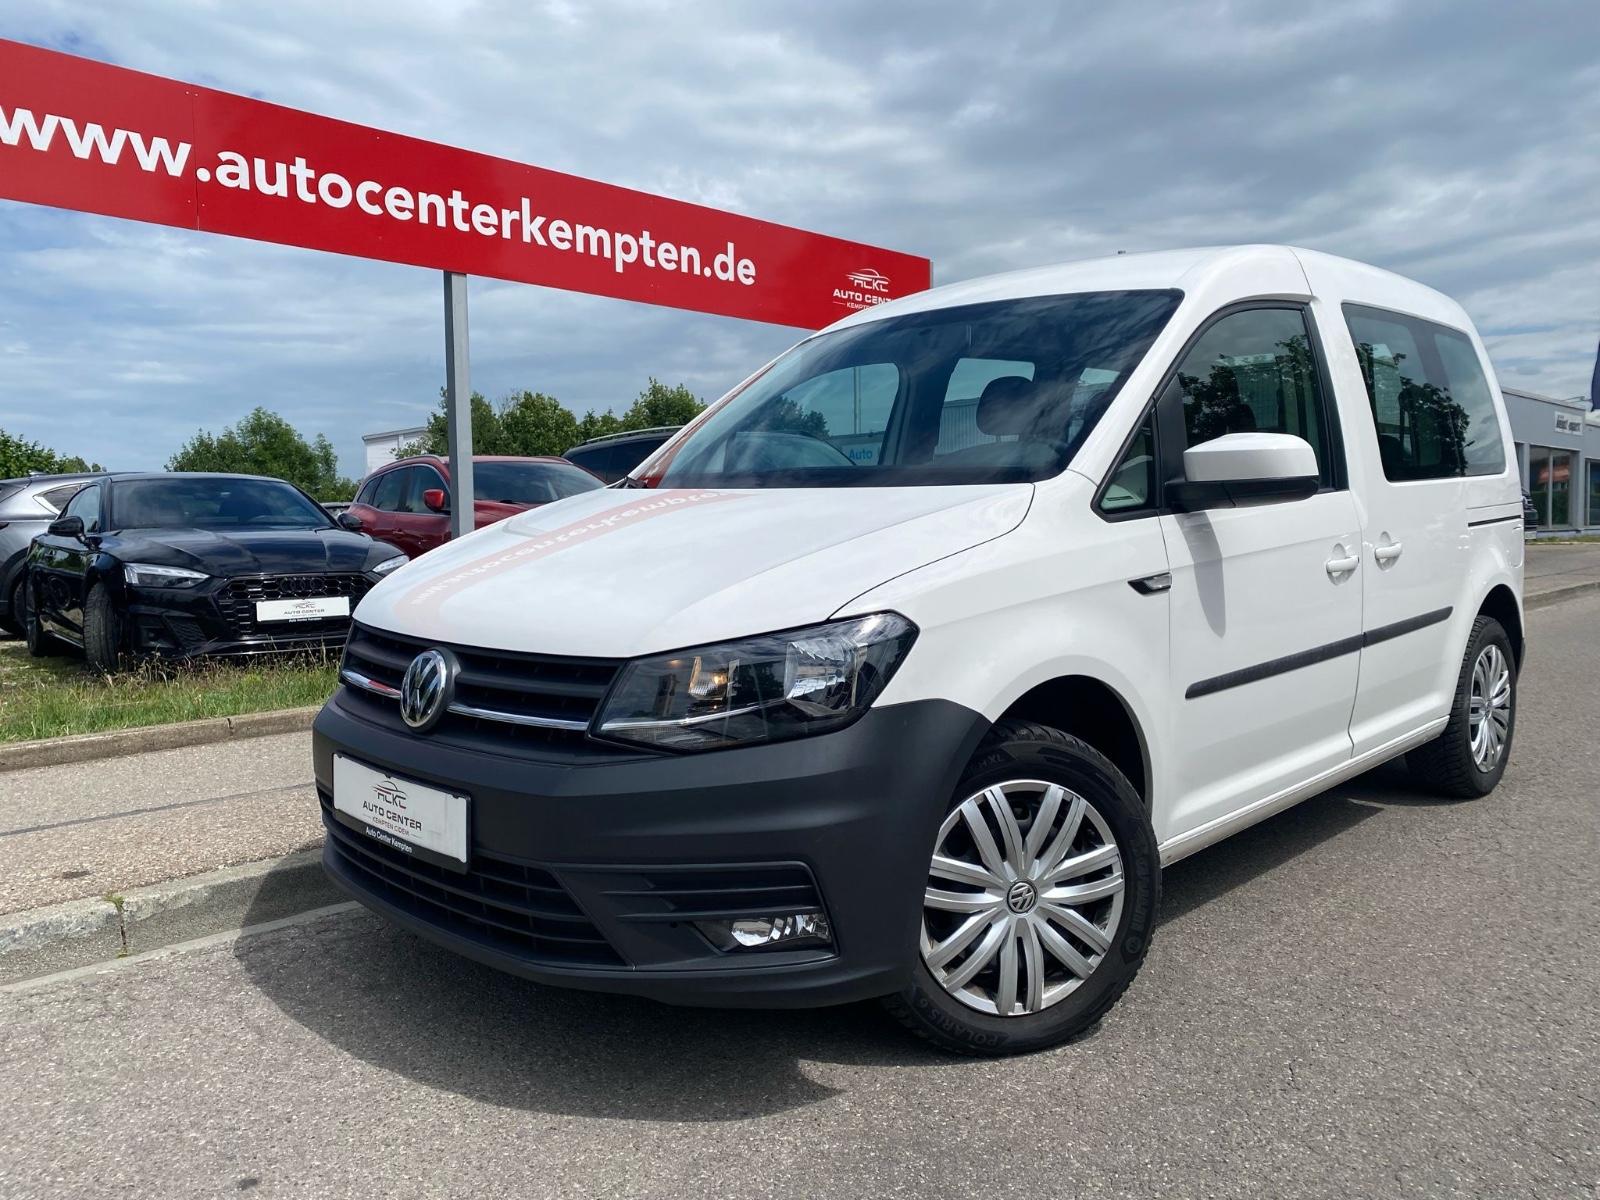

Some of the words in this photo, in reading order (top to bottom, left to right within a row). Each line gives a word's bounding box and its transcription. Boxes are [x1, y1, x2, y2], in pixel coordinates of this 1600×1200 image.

[0, 104, 757, 286] www.autocenterkempten.de
[833, 288, 863, 302] AUTO
[849, 449, 873, 460] Auto
[363, 800, 385, 817] AUTO
[387, 811, 422, 831] CENTER
[928, 1008, 999, 1046] POLARIS
